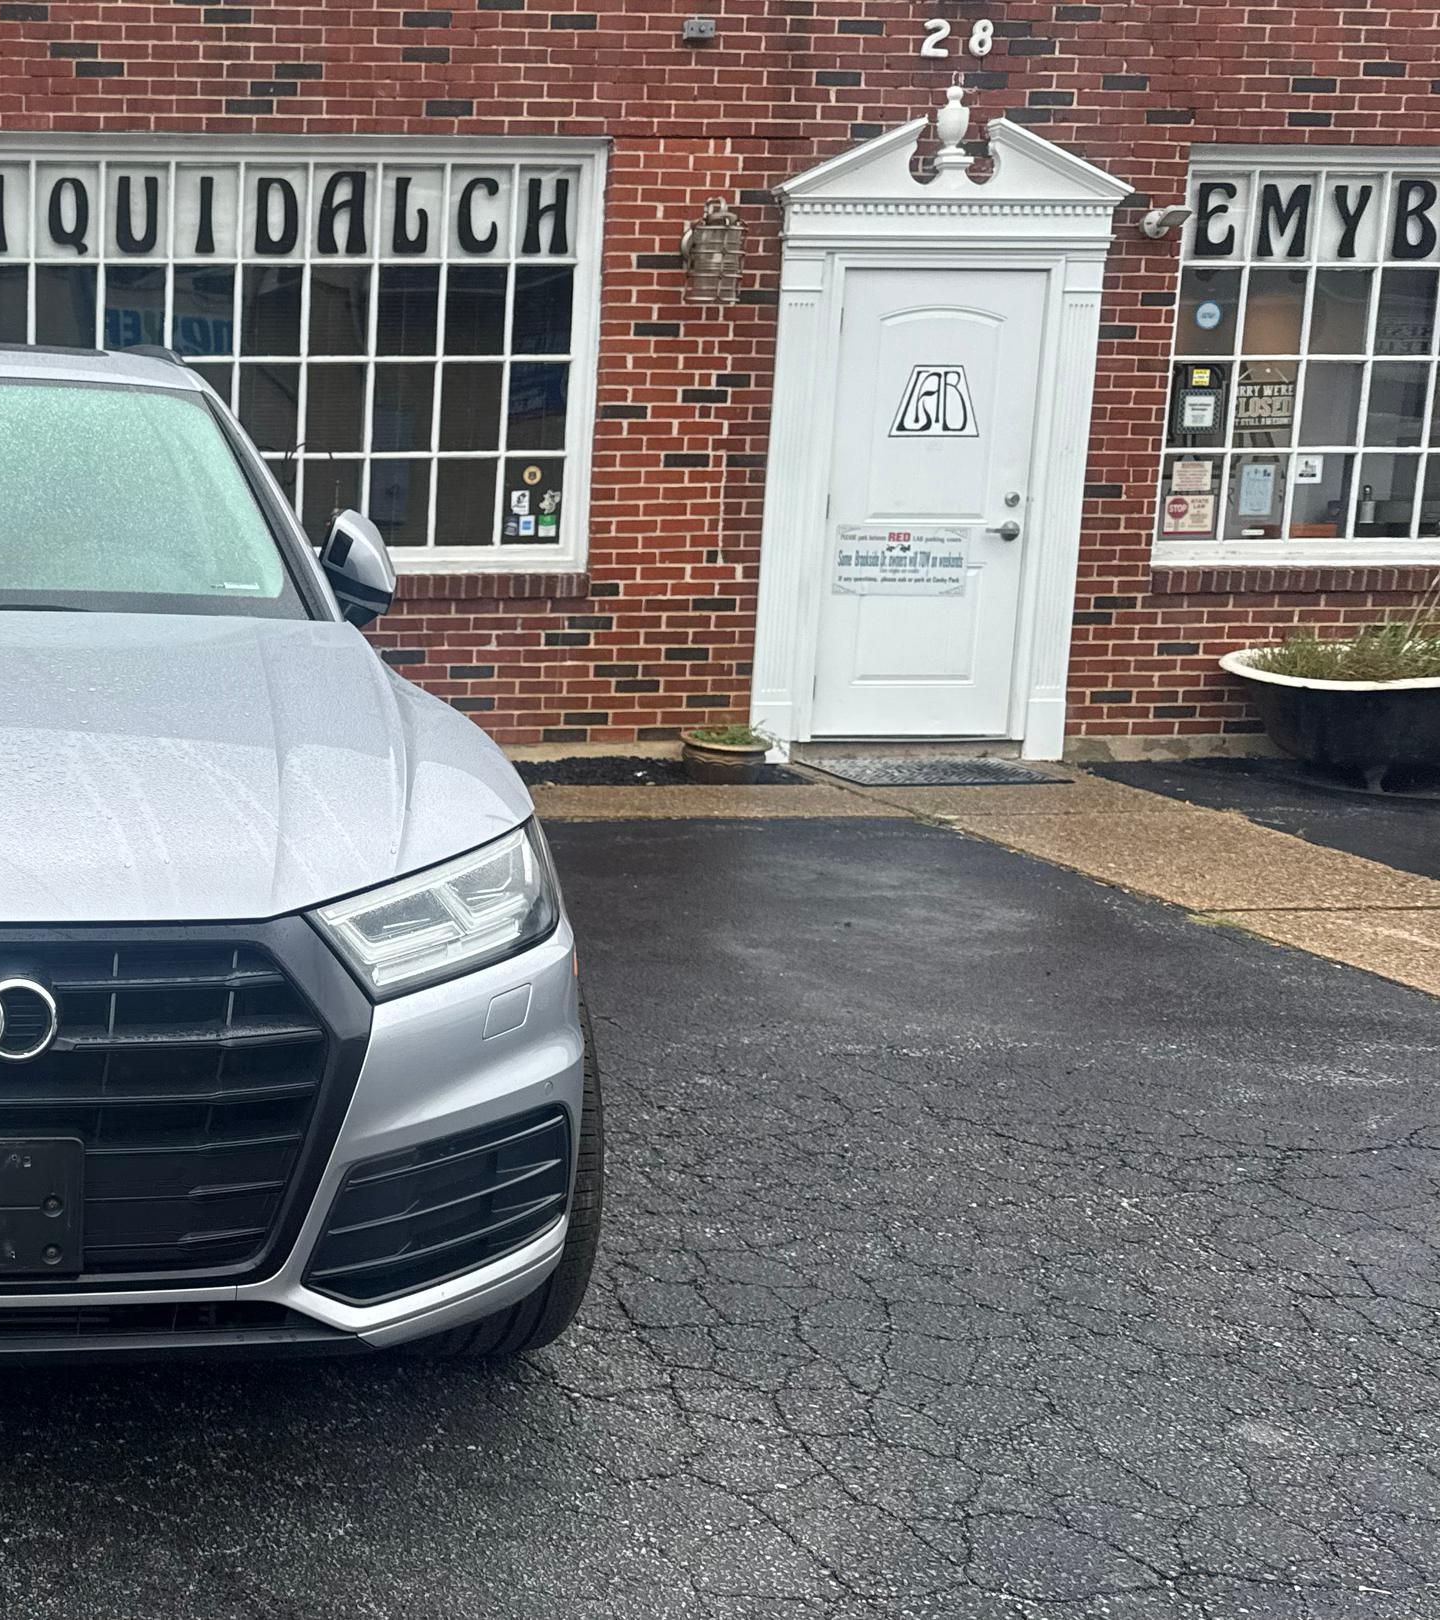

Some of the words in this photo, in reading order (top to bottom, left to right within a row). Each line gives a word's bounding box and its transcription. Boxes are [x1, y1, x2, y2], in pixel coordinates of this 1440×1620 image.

[921, 19, 994, 57] 28
[1238, 385, 1260, 396] RRY
[1168, 504, 1188, 513] STOP
[888, 532, 911, 542] RED
